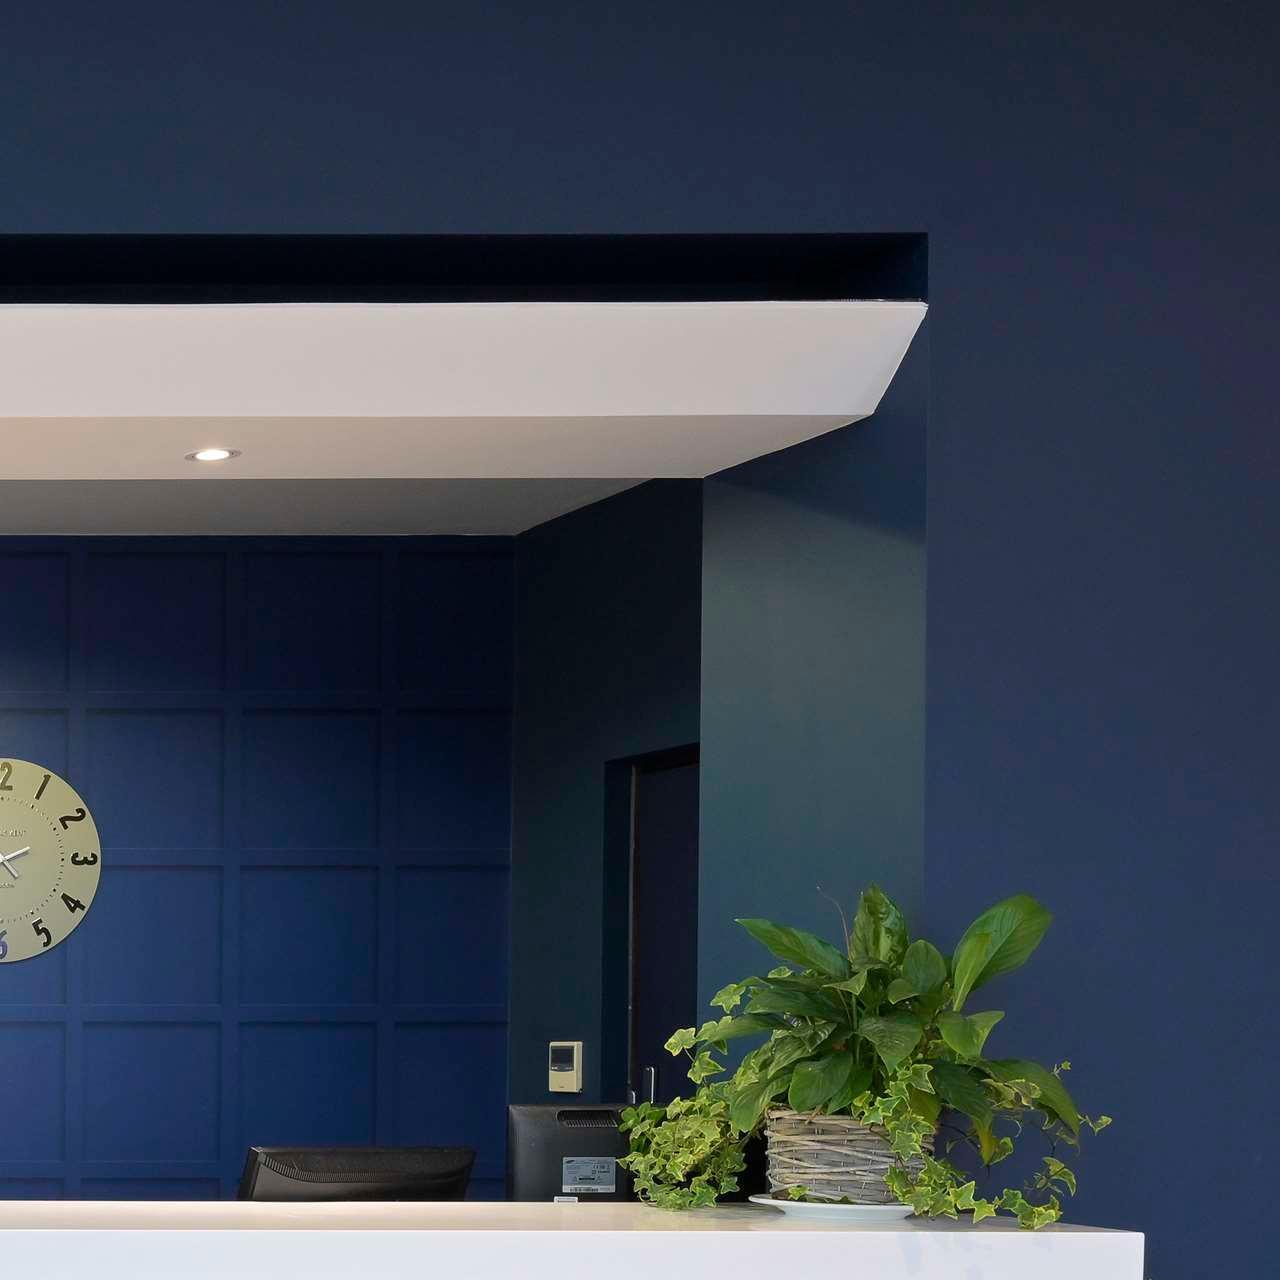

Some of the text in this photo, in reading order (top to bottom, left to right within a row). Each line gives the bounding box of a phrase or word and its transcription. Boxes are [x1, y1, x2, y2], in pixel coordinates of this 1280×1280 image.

[34, 774, 51, 800] 1
[58, 808, 87, 830] 2
[70, 852, 98, 866] 3
[60, 893, 86, 914] 4
[32, 917, 52, 948] 5
